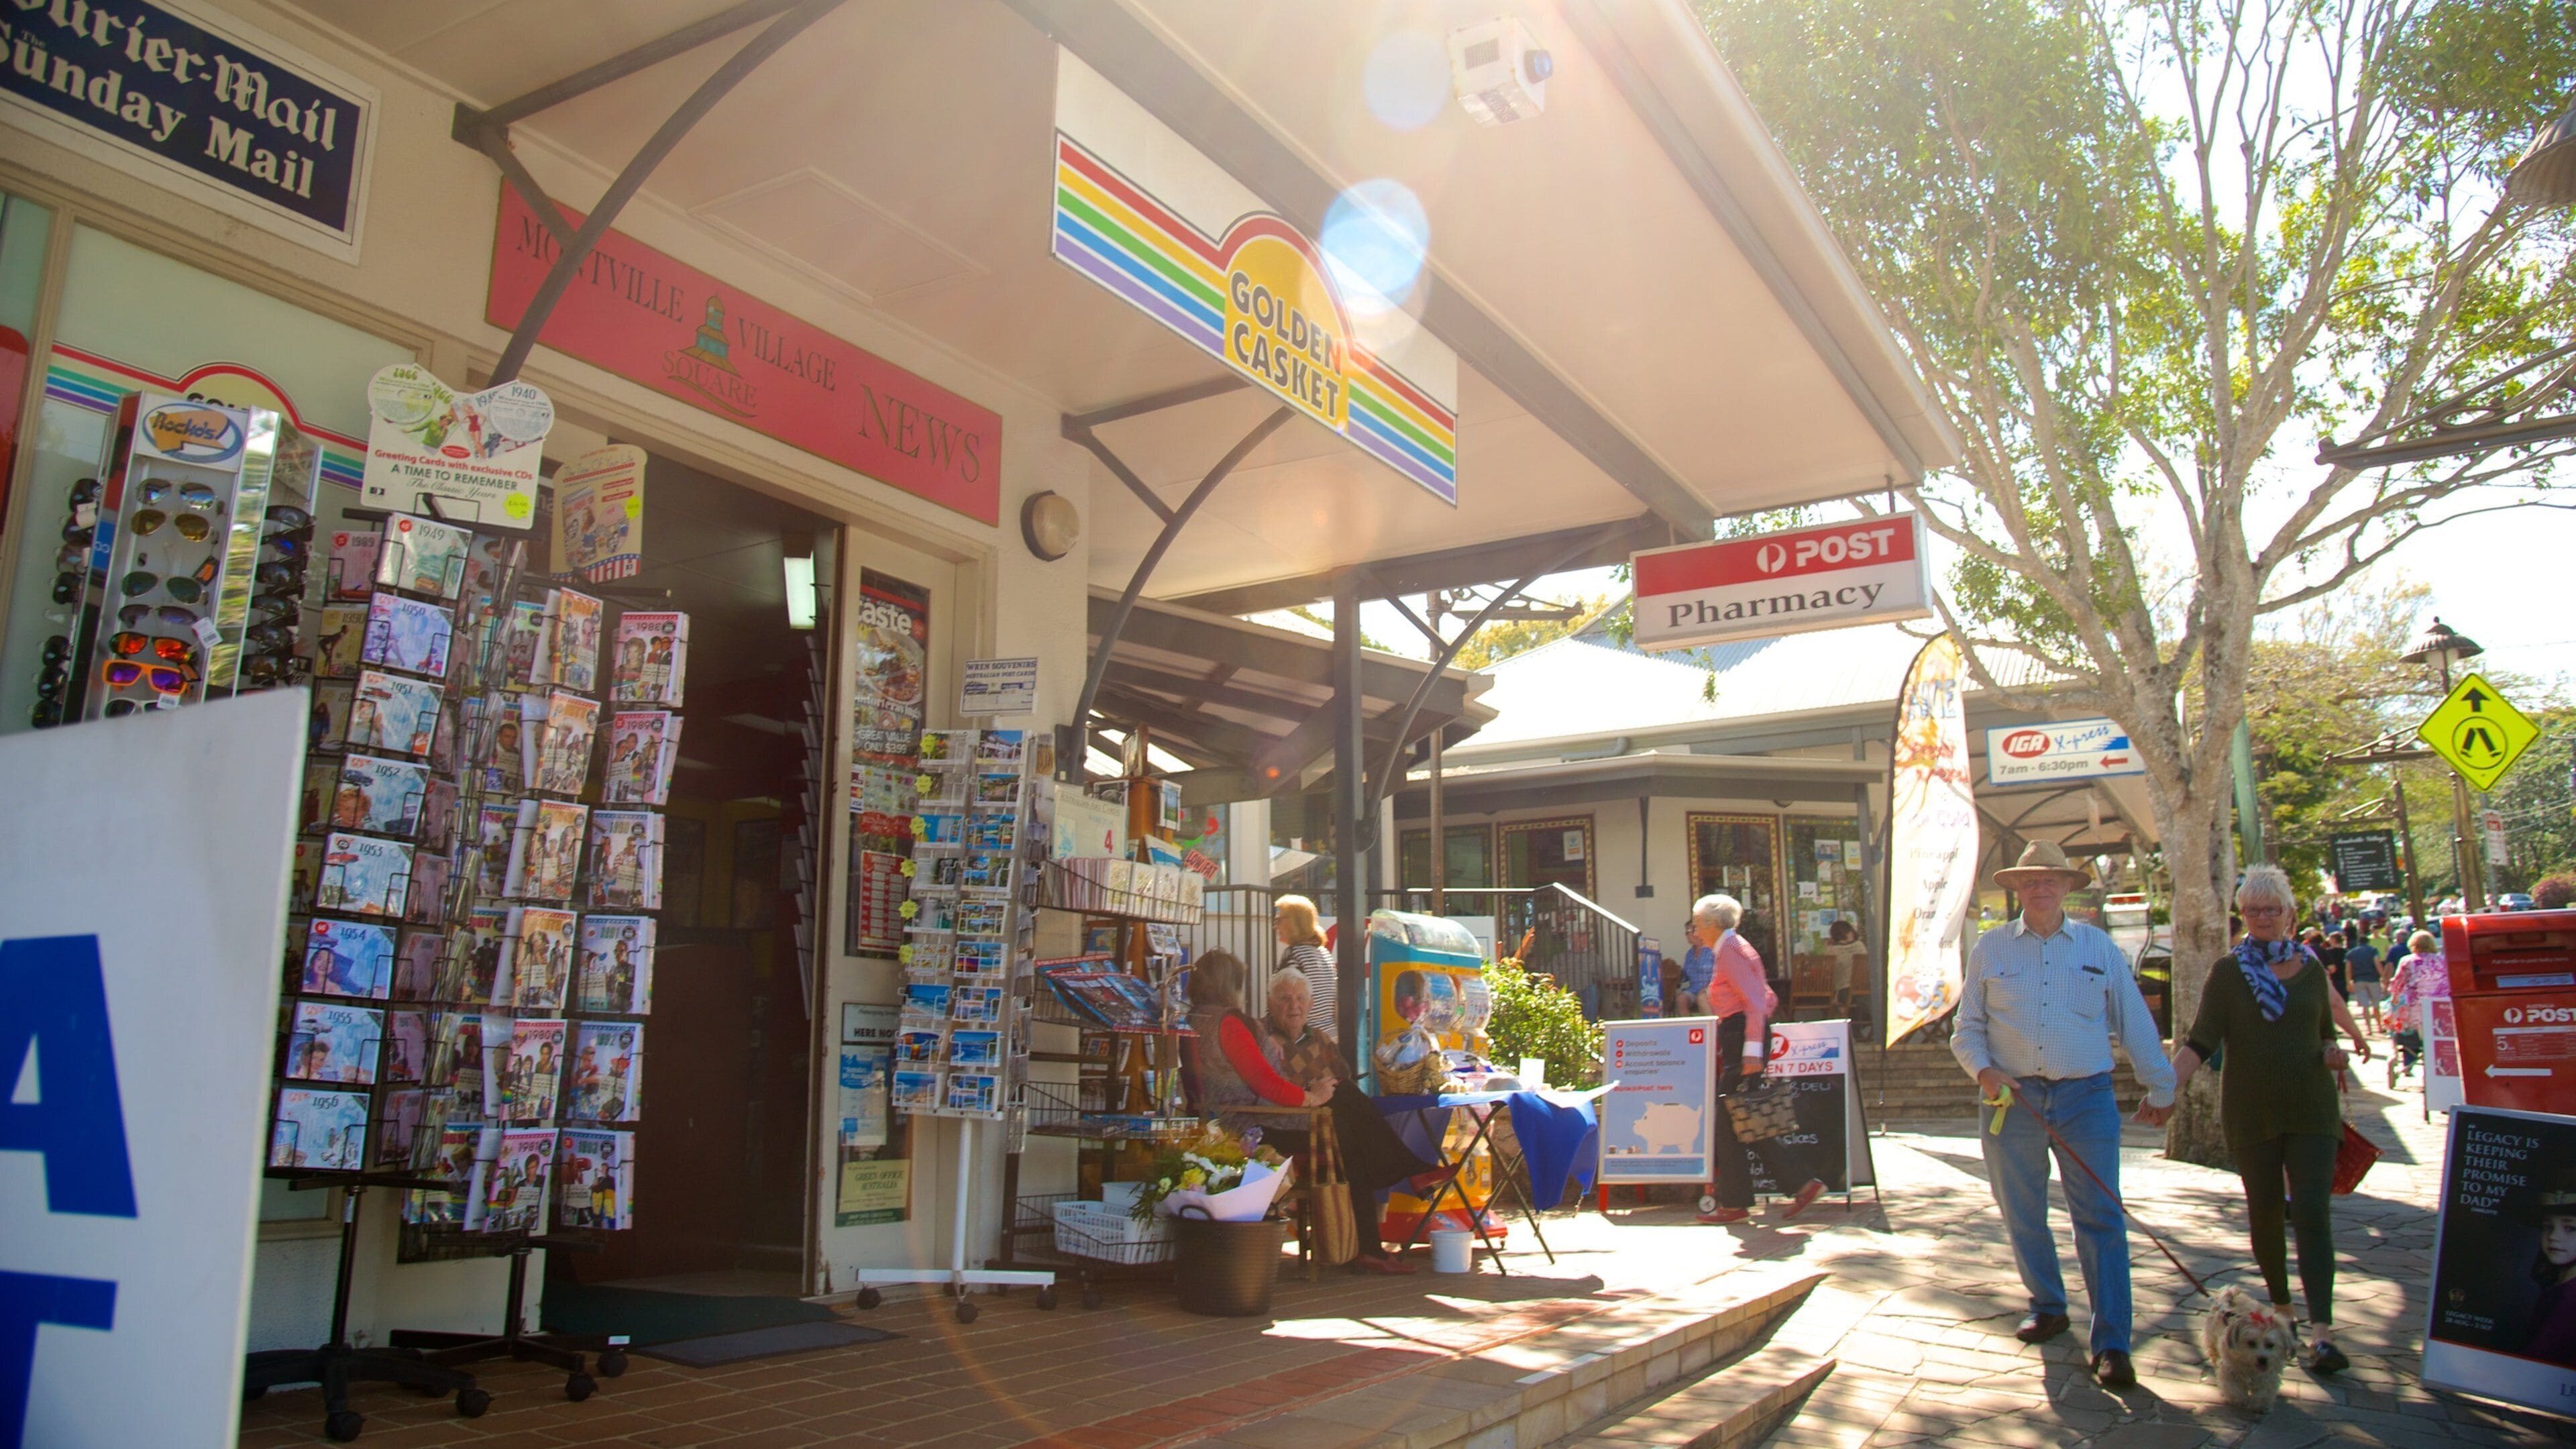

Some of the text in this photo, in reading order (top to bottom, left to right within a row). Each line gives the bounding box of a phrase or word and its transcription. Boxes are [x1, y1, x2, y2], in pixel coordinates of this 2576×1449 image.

[21, 30, 45, 48] The
[205, 116, 314, 199] Mail
[516, 215, 837, 391] MOTVILLE VILLAGE
[1230, 271, 1342, 376] GOLDEN
[661, 350, 757, 410] SQUARE
[1233, 322, 1339, 419] CASKET
[511, 386, 537, 400] 1940
[857, 382, 981, 484] NEWS
[374, 449, 533, 481] Greeting Cards with exclusive CDs
[390, 464, 519, 491] A TIME TO REMEMBER
[418, 525, 445, 541] 1949
[1795, 527, 1894, 568] POST
[1667, 582, 1884, 628] Pharmacy
[2007, 725, 2110, 754] IGA X-press
[1999, 765, 2028, 775] 7am
[2038, 759, 2088, 773] 6:30pm
[854, 1028, 876, 1038] HERE
[2496, 1036, 2508, 1051] 5
[1766, 1061, 1833, 1075] EN 7 DAYS
[2465, 1142, 2528, 1161] KEEPING
[2526, 1137, 2540, 1148] IS
[2464, 1155, 2508, 1171] THEIR
[2463, 1167, 2528, 1187] PROMISE
[2461, 1180, 2509, 1197] TO MY
